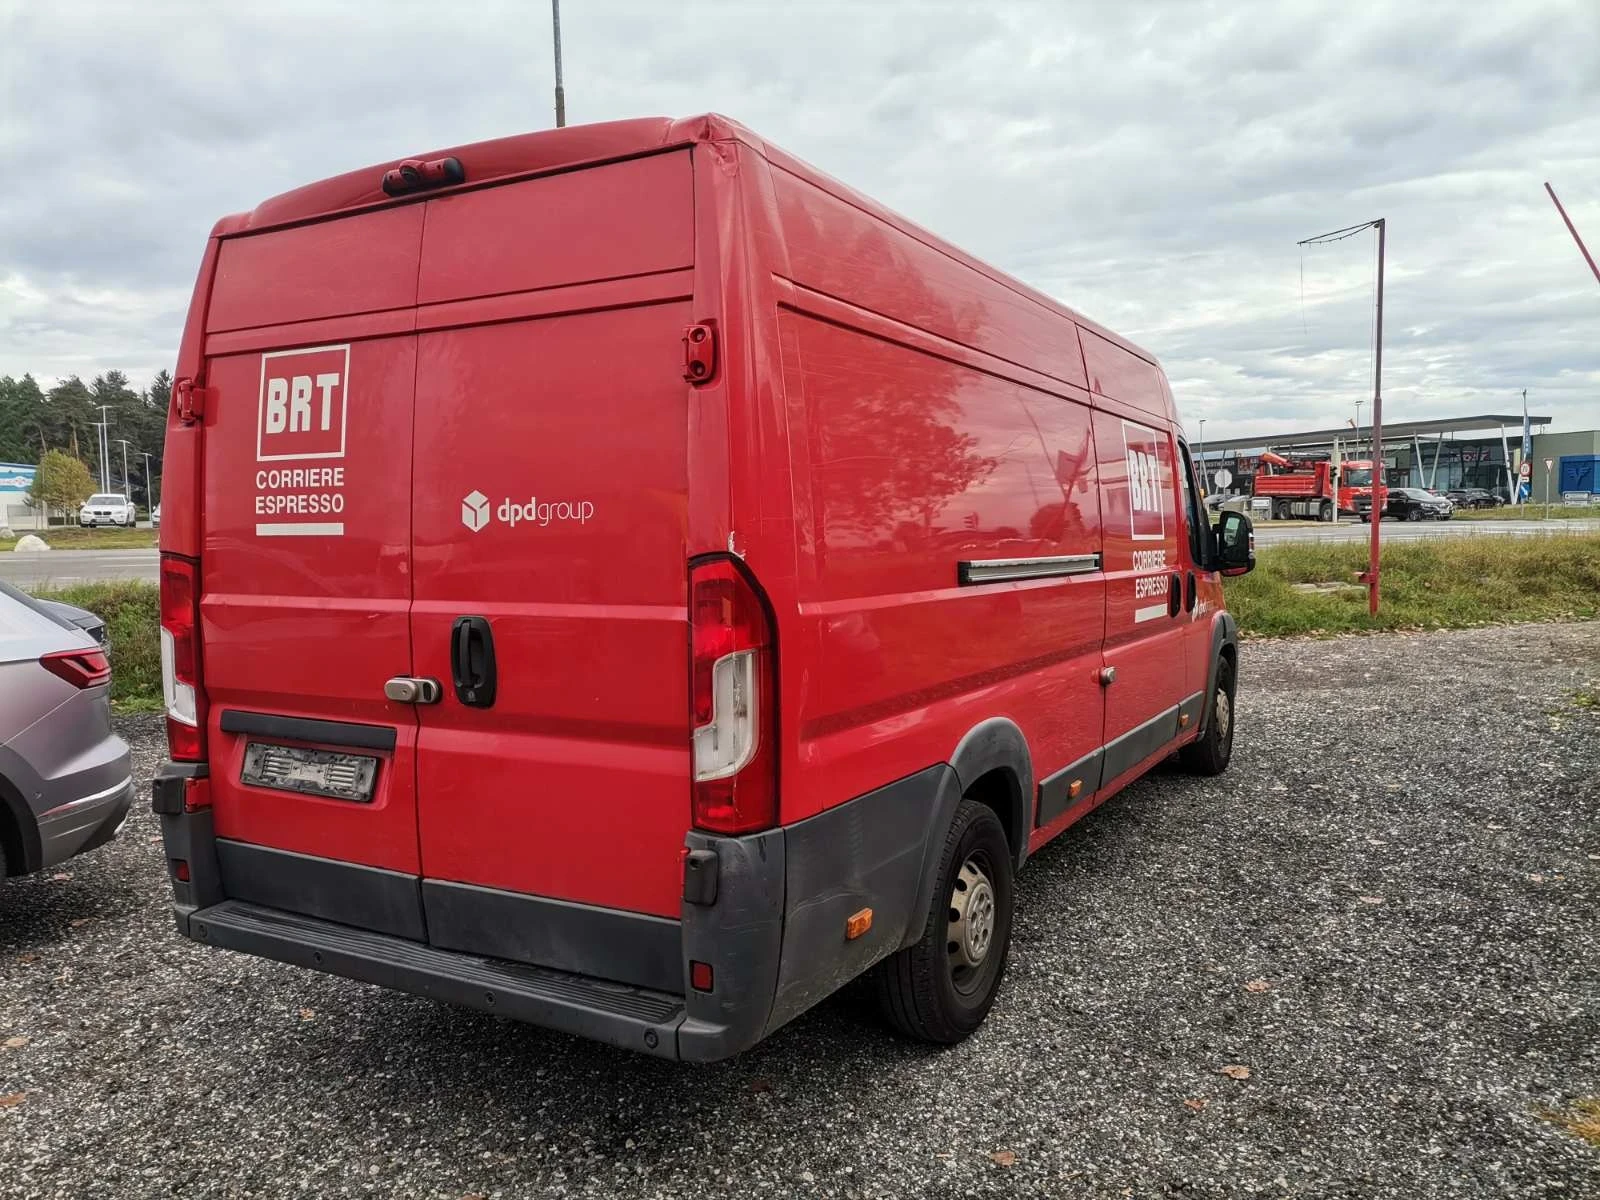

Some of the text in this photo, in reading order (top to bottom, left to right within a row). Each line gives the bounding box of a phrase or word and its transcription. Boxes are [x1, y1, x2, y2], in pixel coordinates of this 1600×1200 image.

[265, 372, 340, 435] BRT
[256, 467, 345, 490] CORRIERE
[1128, 449, 1159, 513] BRT
[255, 493, 344, 515] ESPRESSO
[497, 496, 594, 528] dpdgroup
[1132, 549, 1166, 571] CORRIERE
[1135, 575, 1168, 599] ESPRESSO
